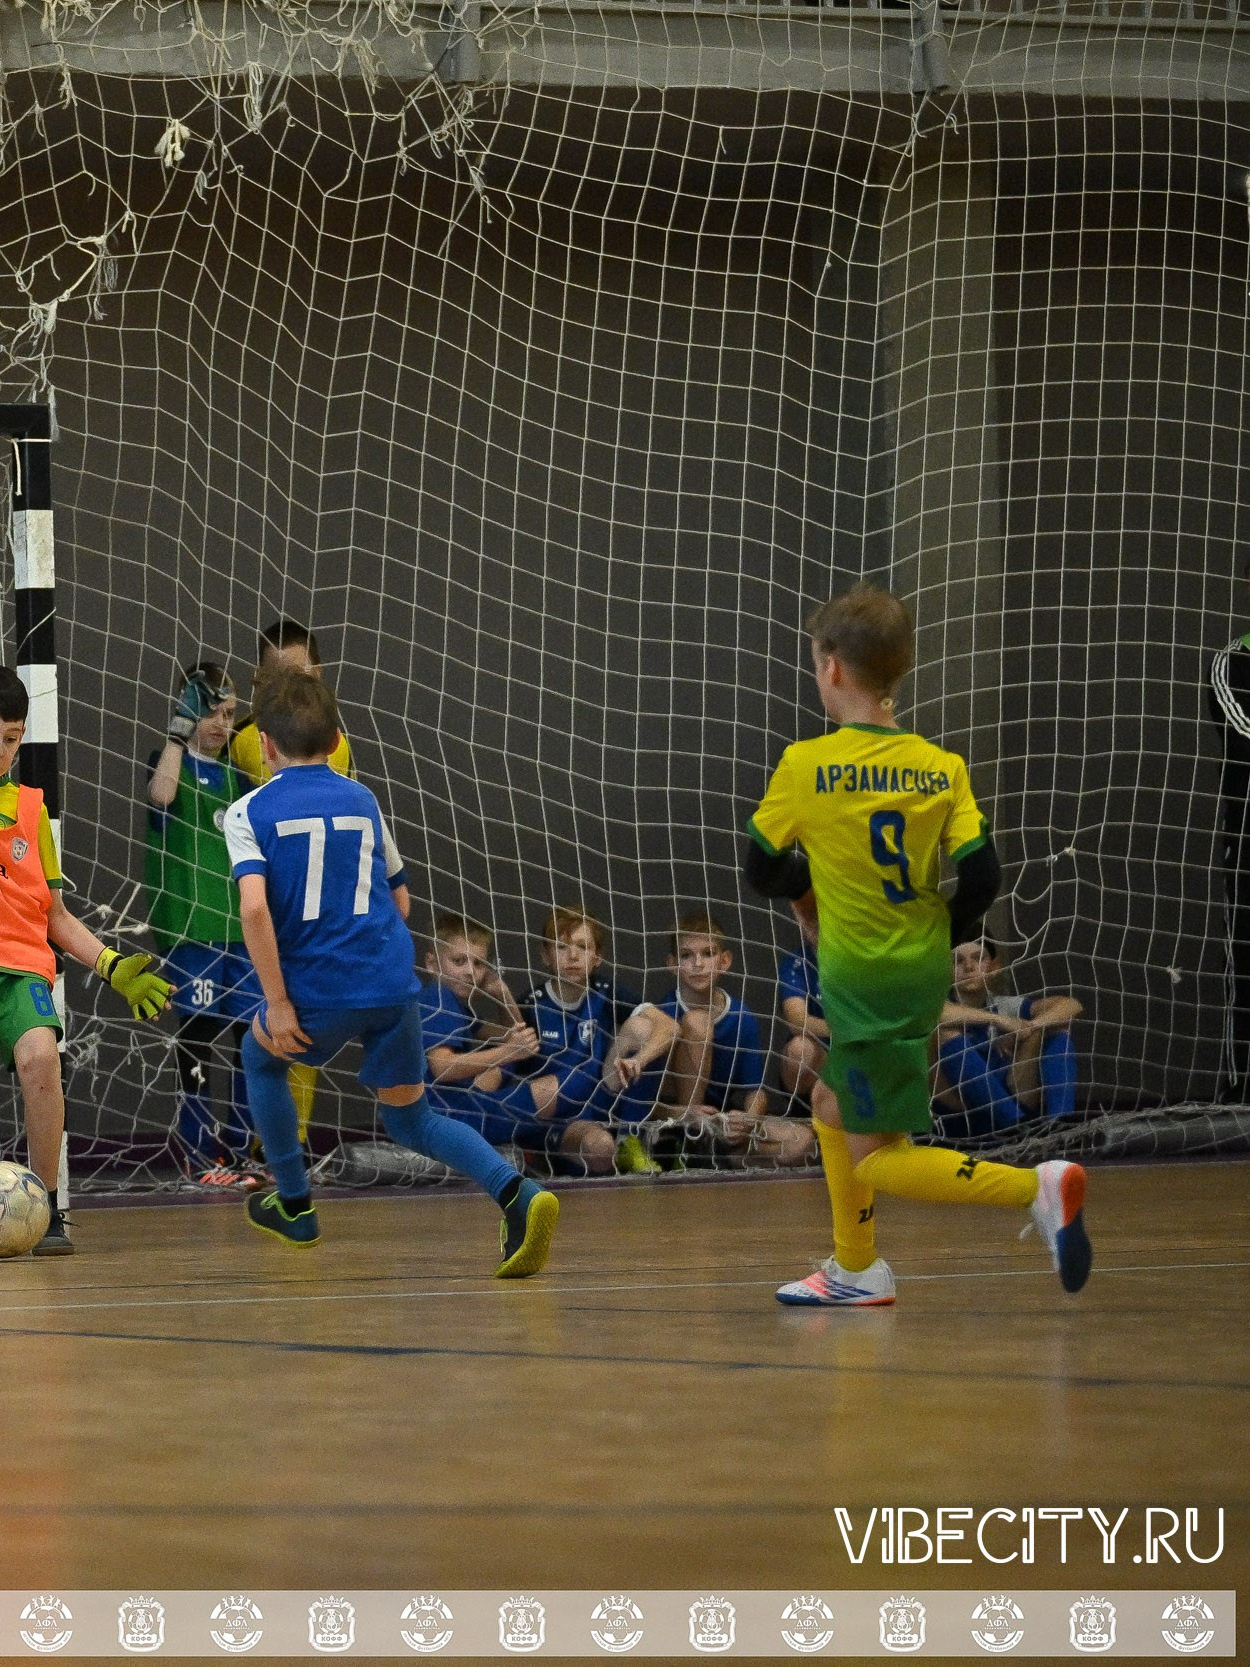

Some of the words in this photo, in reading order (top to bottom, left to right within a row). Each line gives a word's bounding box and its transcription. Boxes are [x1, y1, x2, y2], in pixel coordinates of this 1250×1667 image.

[275, 815, 375, 921] 77
[869, 810, 917, 905] 9
[29, 982, 54, 1017] 8
[191, 978, 215, 1006] 36
